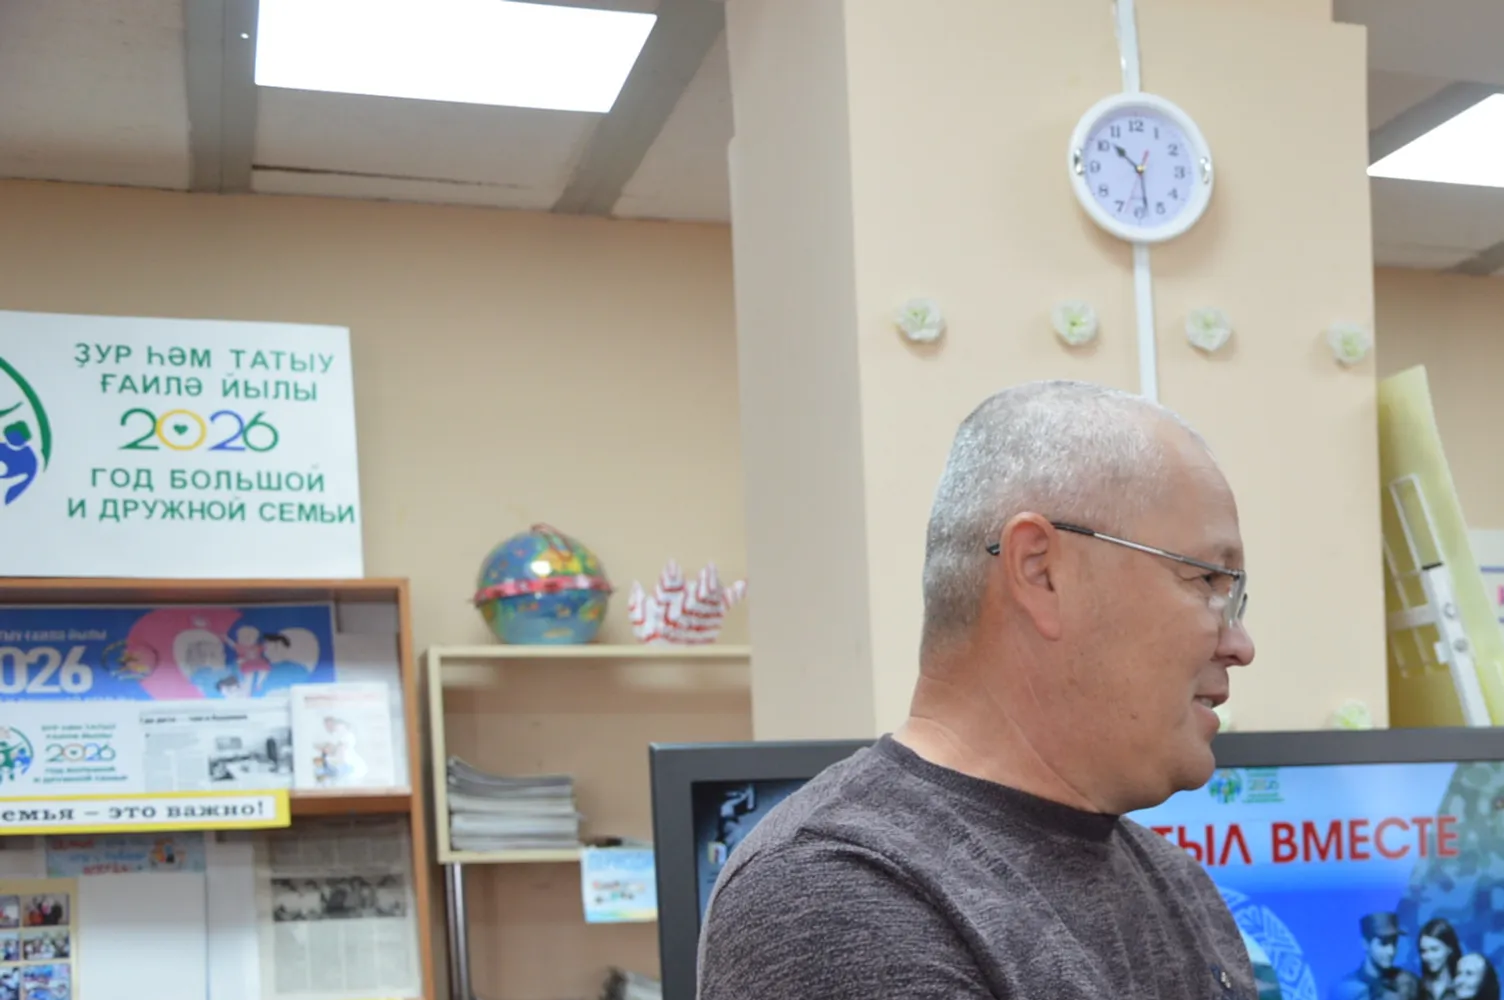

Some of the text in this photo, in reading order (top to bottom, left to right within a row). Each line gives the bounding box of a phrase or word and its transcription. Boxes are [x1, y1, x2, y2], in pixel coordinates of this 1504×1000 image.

[1128, 119, 1144, 133] 12
[229, 348, 335, 374] ТАТЫУ
[222, 372, 318, 402] ЙЫЛЫ
[118, 407, 280, 453] 2026
[91, 463, 326, 493] ГОД БОЛЬШОЙ
[67, 496, 356, 524] И ДРУЖНОЙ СЕМЬИ
[108, 806, 157, 819] это
[166, 800, 264, 818] важно!
[1271, 815, 1462, 864] ВМЕСТЕ
